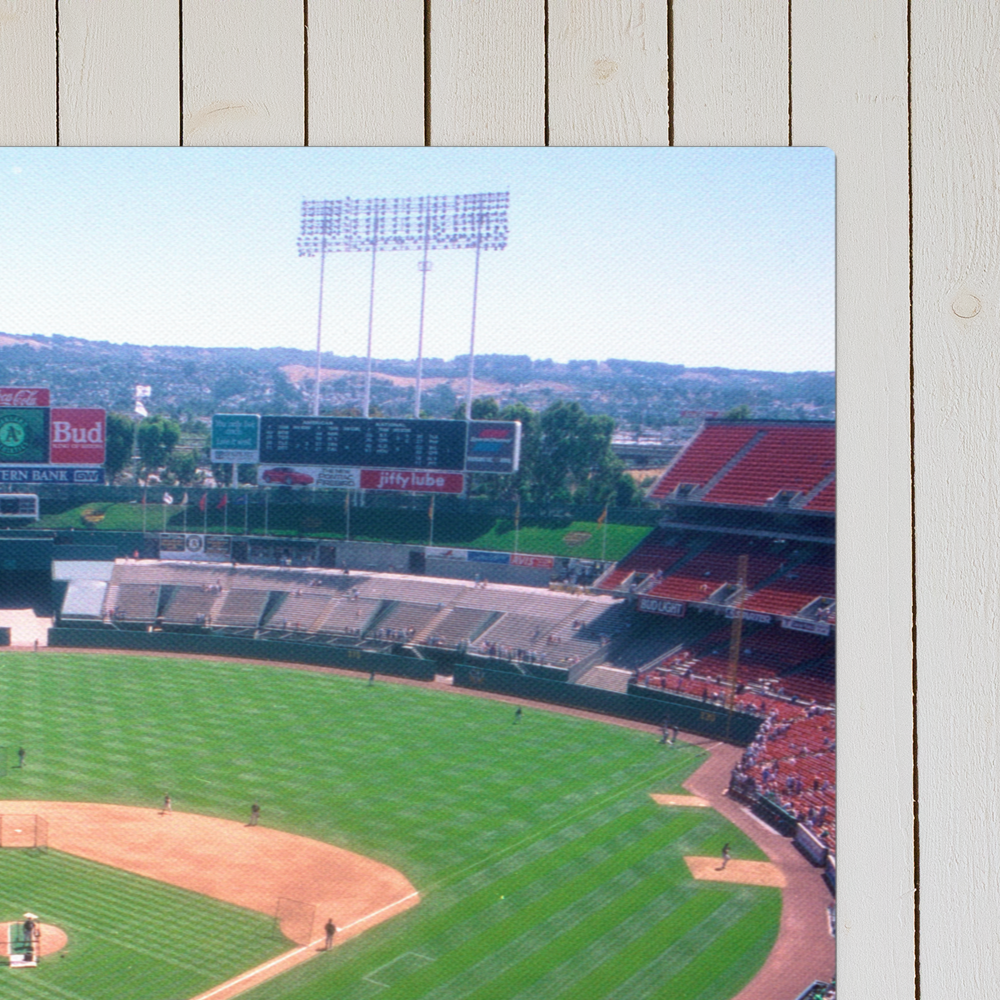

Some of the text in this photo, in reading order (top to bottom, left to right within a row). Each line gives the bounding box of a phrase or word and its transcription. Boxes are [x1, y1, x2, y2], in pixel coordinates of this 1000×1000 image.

[53, 421, 103, 443] Bud
[32, 470, 68, 481] BANK
[377, 471, 445, 488] jiffy lube
[512, 555, 534, 566] AVIS
[640, 599, 682, 614] BUD LIGHT
